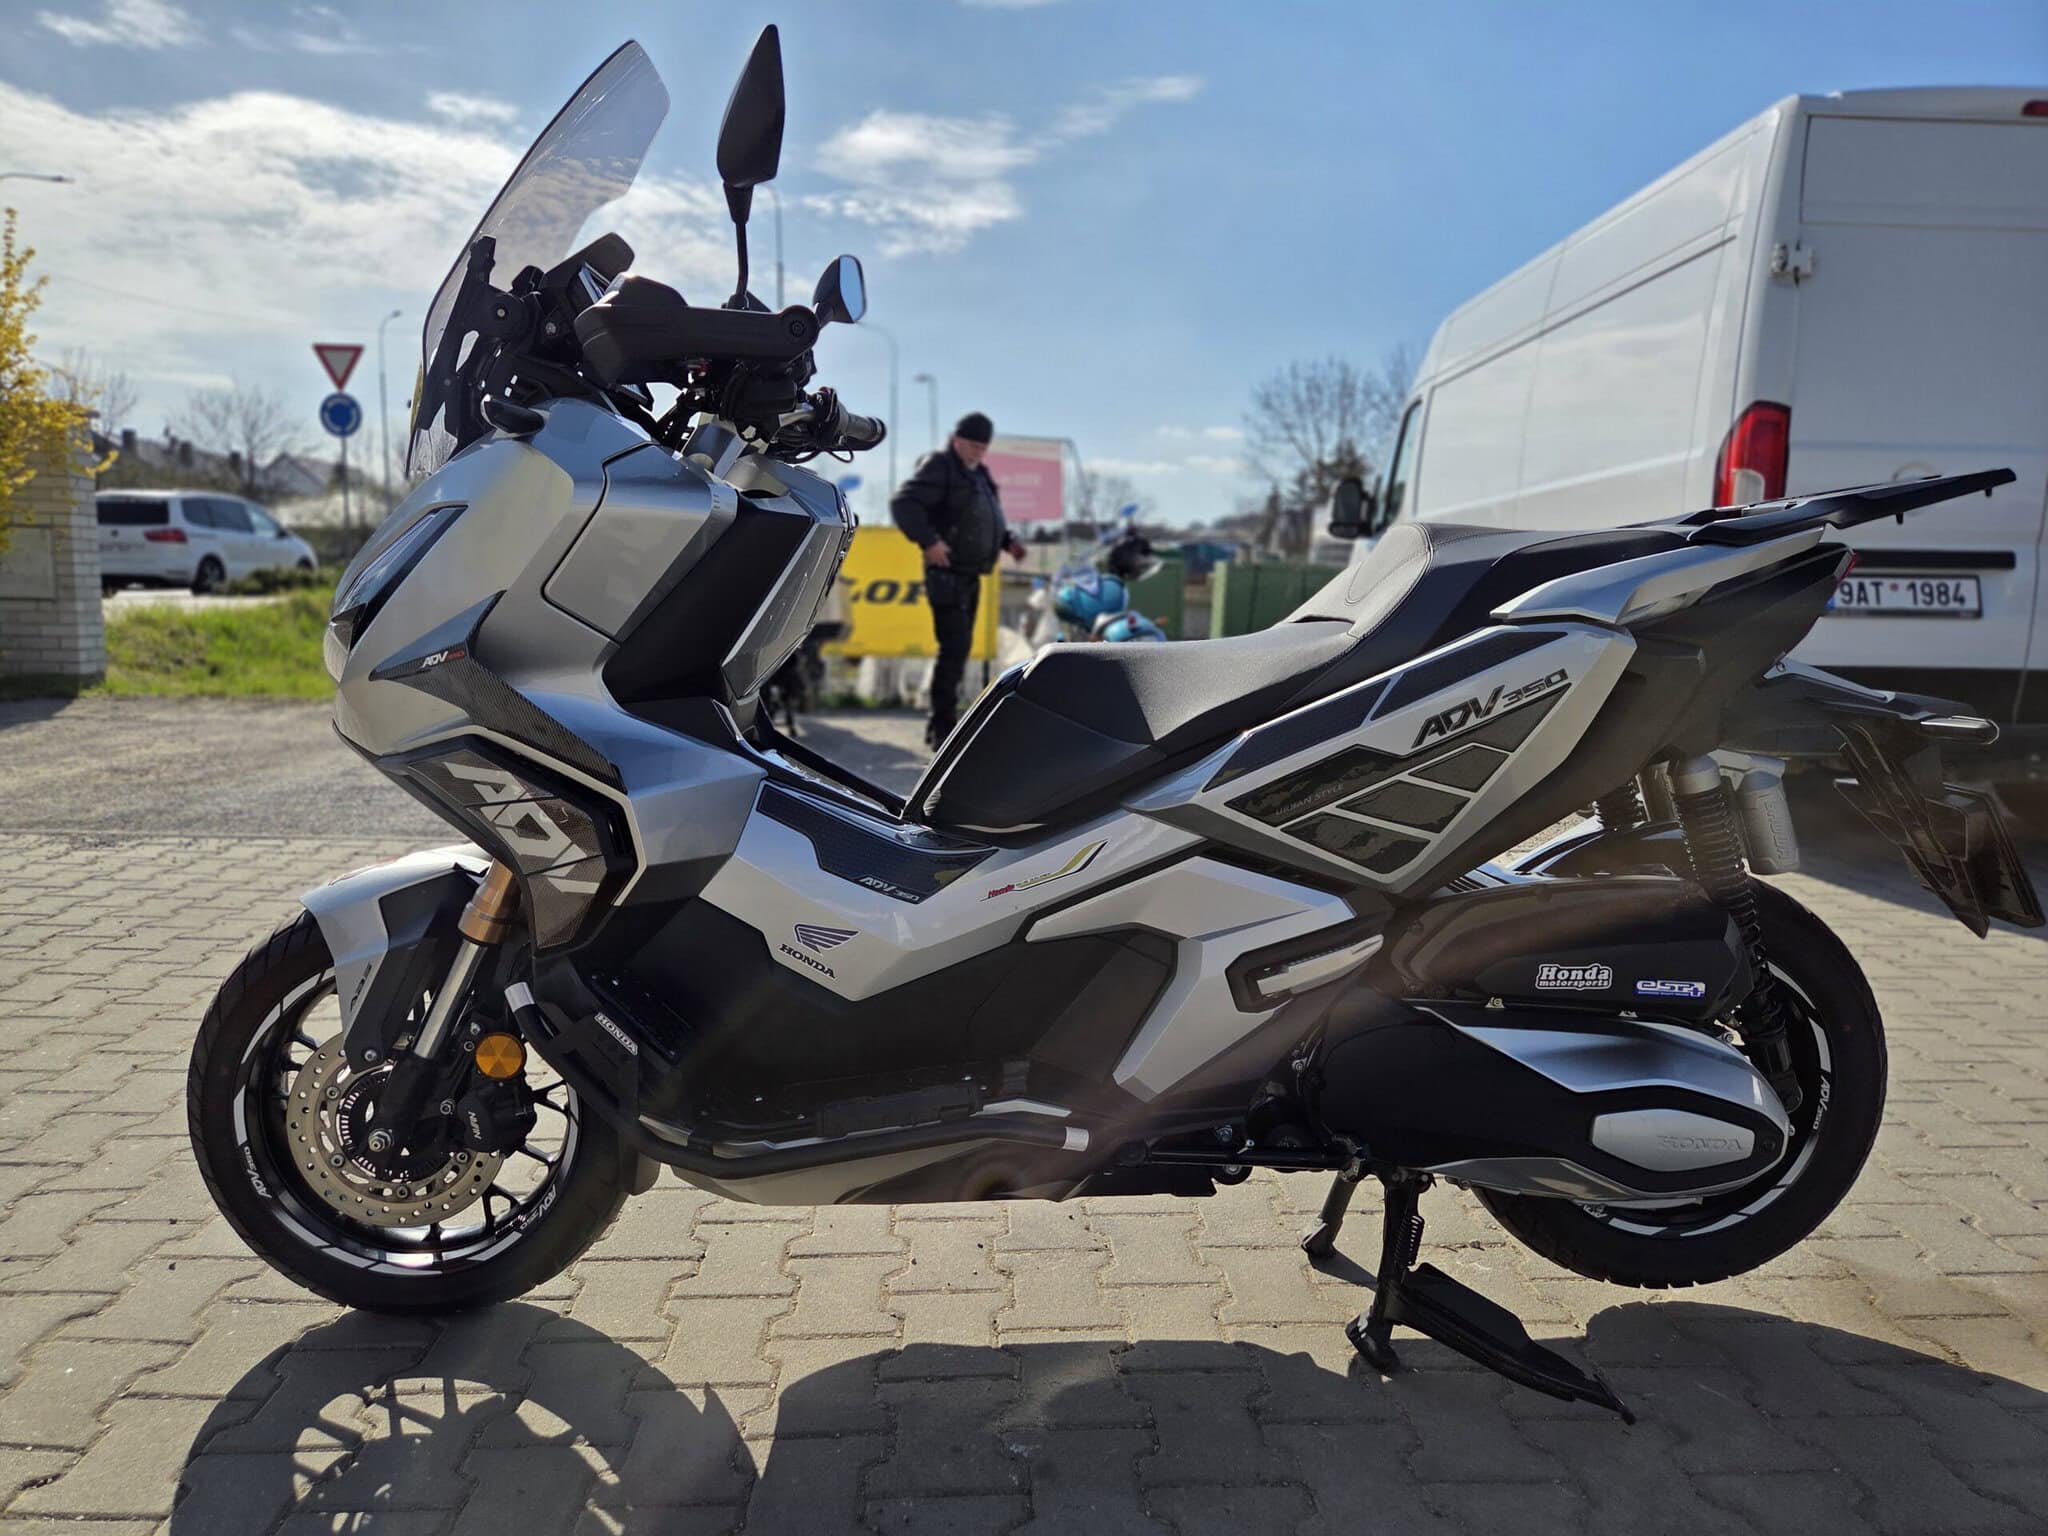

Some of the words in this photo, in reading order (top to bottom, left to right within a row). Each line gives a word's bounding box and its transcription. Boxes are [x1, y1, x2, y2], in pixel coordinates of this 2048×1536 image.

[1839, 581, 1883, 605] 9AT
[1906, 581, 1966, 606] 1984
[1314, 780, 1344, 800] STYLE
[779, 943, 836, 979] HONDA
[1540, 966, 1609, 981] Honda
[1539, 979, 1609, 989] motorsports
[596, 1013, 636, 1053] HONDA
[1656, 1134, 1743, 1152] HONDA
